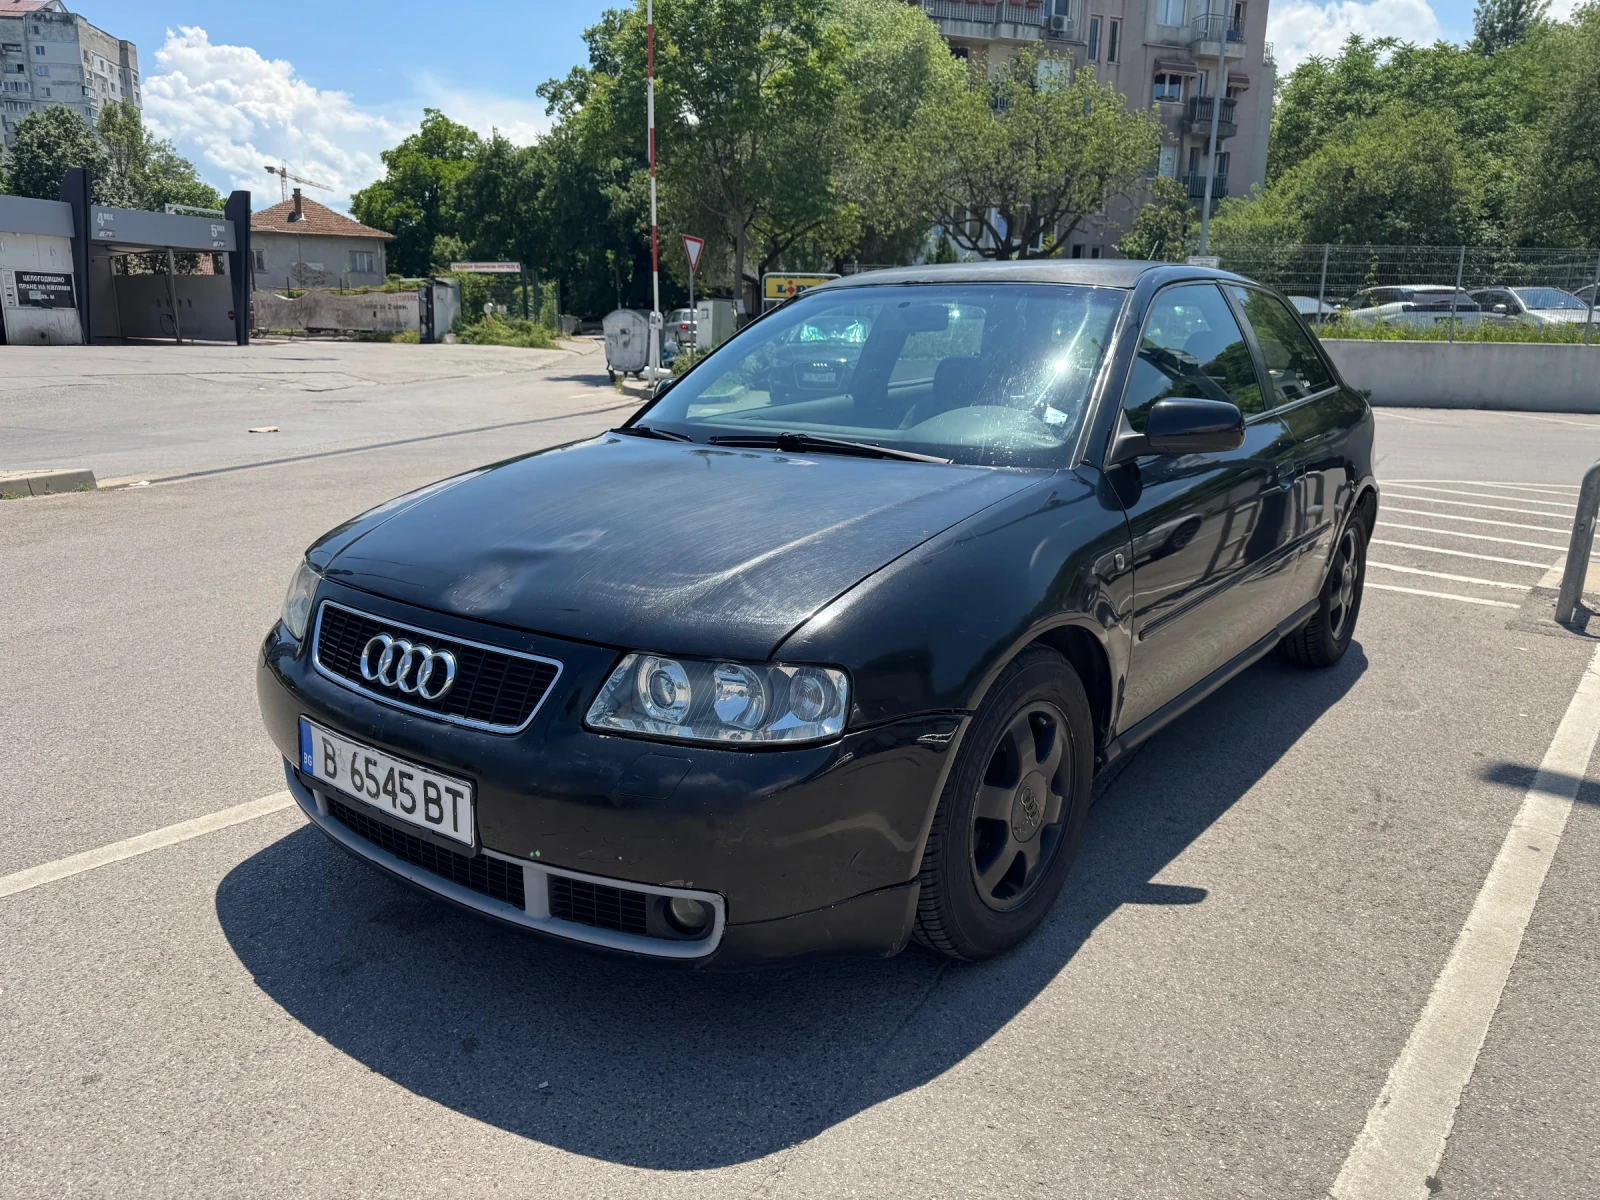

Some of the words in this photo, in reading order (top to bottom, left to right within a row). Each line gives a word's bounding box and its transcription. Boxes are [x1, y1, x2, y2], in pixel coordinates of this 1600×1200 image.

[97, 212, 105, 227] 4
[104, 212, 114, 221] BOX
[210, 224, 218, 238] 5
[303, 751, 312, 767] BG
[322, 736, 337, 780] B
[350, 751, 417, 815] 6545
[423, 780, 464, 833] BT
